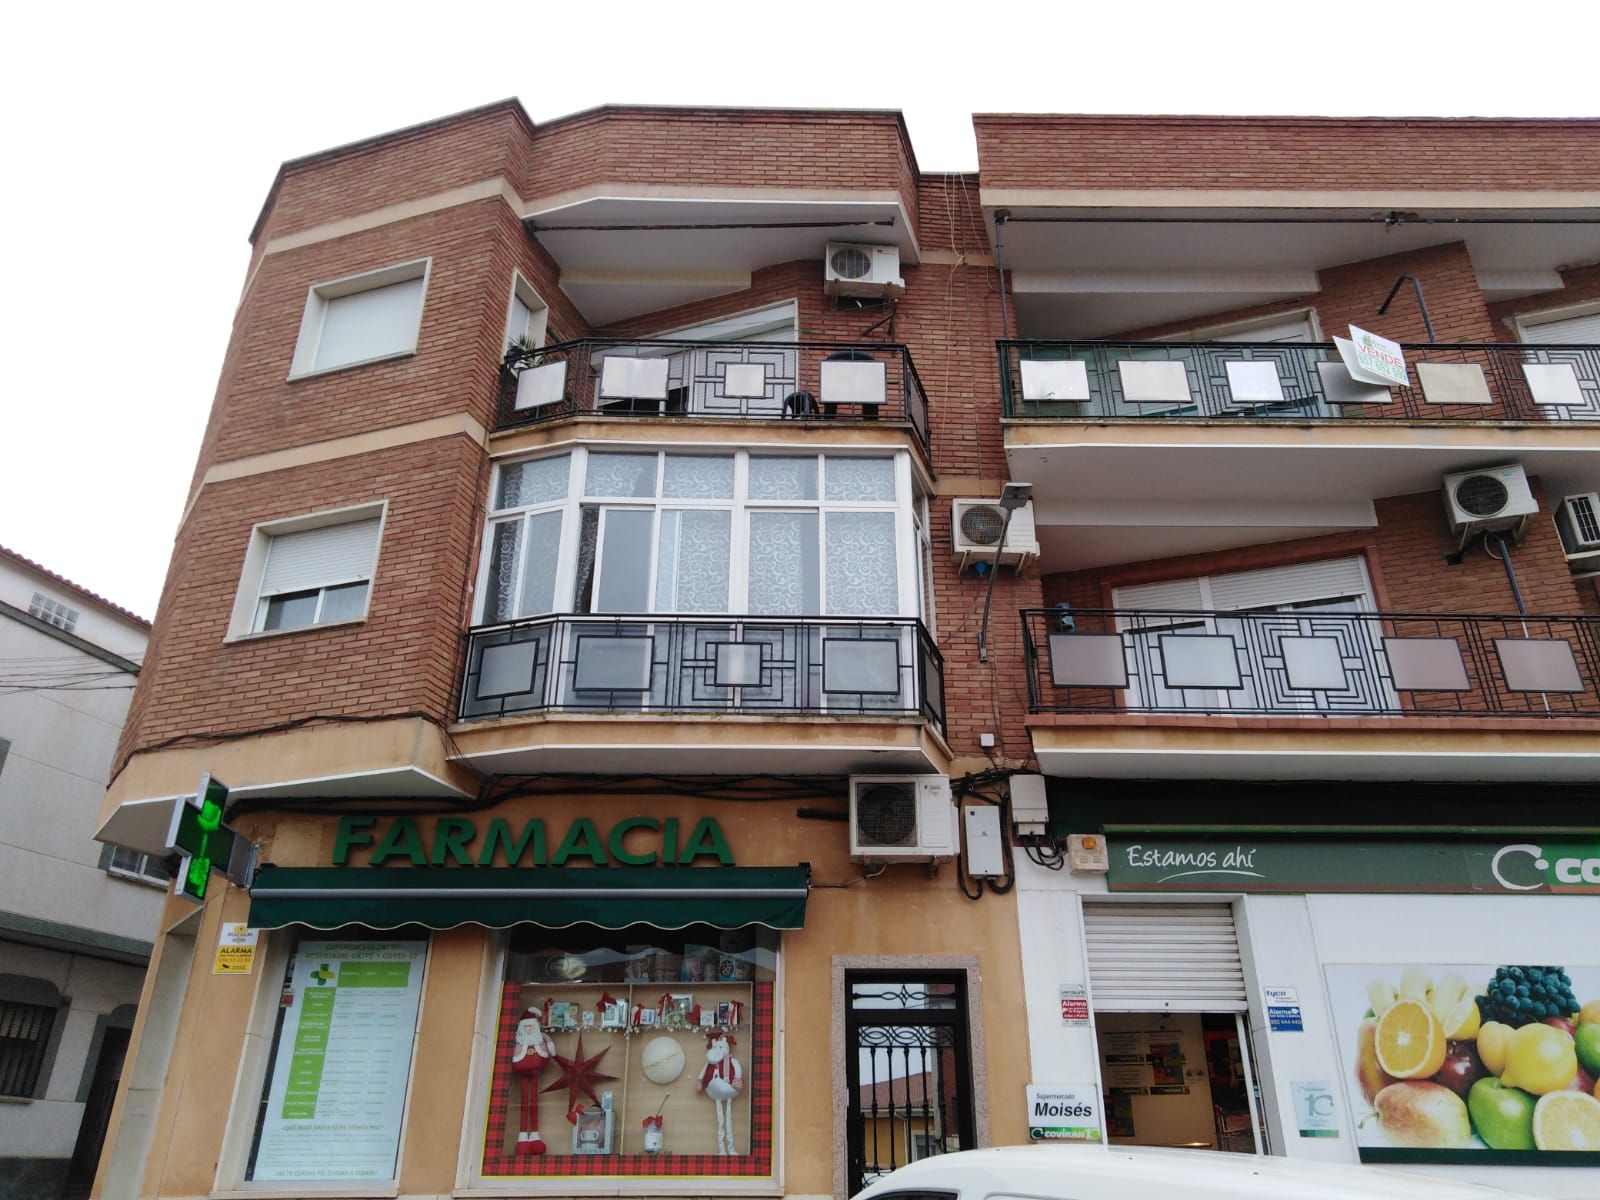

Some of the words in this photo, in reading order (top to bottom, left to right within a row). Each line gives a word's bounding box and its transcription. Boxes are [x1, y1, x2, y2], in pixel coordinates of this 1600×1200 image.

[1358, 344, 1403, 367] VENDE
[332, 815, 737, 867] FARMACIA
[1126, 845, 1216, 867] Estamos
[1222, 846, 1256, 868] ahí
[1266, 990, 1287, 998] tyco
[1034, 1102, 1092, 1117] Moisés
